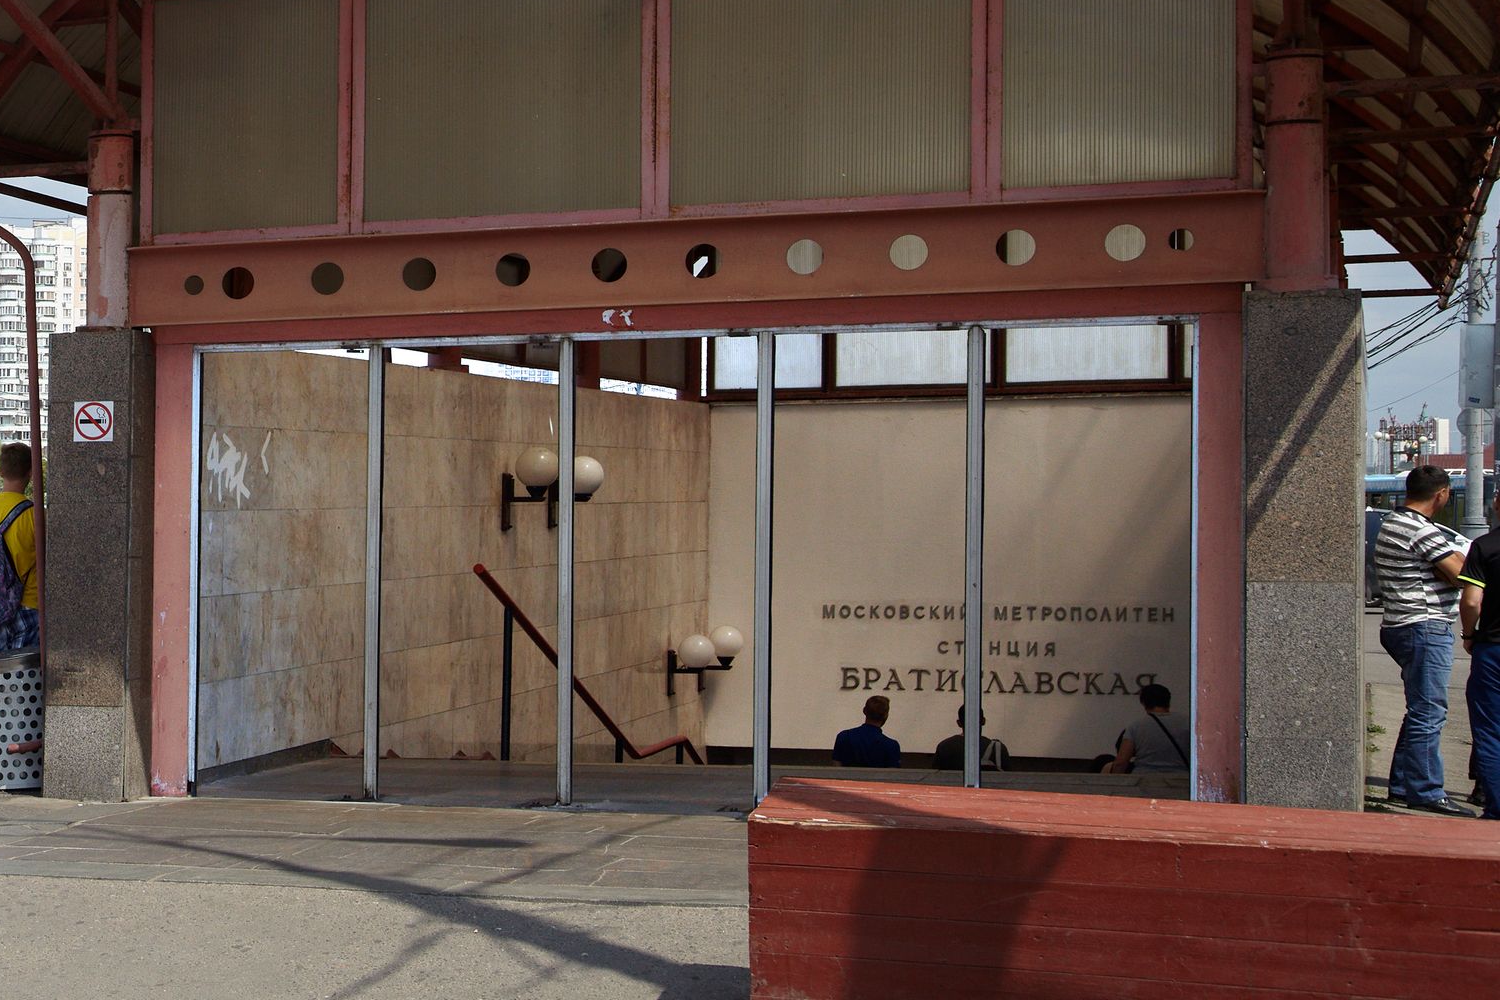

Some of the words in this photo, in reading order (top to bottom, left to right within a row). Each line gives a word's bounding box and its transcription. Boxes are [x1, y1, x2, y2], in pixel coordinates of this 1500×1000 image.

[993, 605, 1175, 624] МЕТРОПОЛИТЕН
[937, 640, 1057, 659] СТНЦИЯ
[840, 666, 1158, 697] БРАТИЛАВСКАЯ
